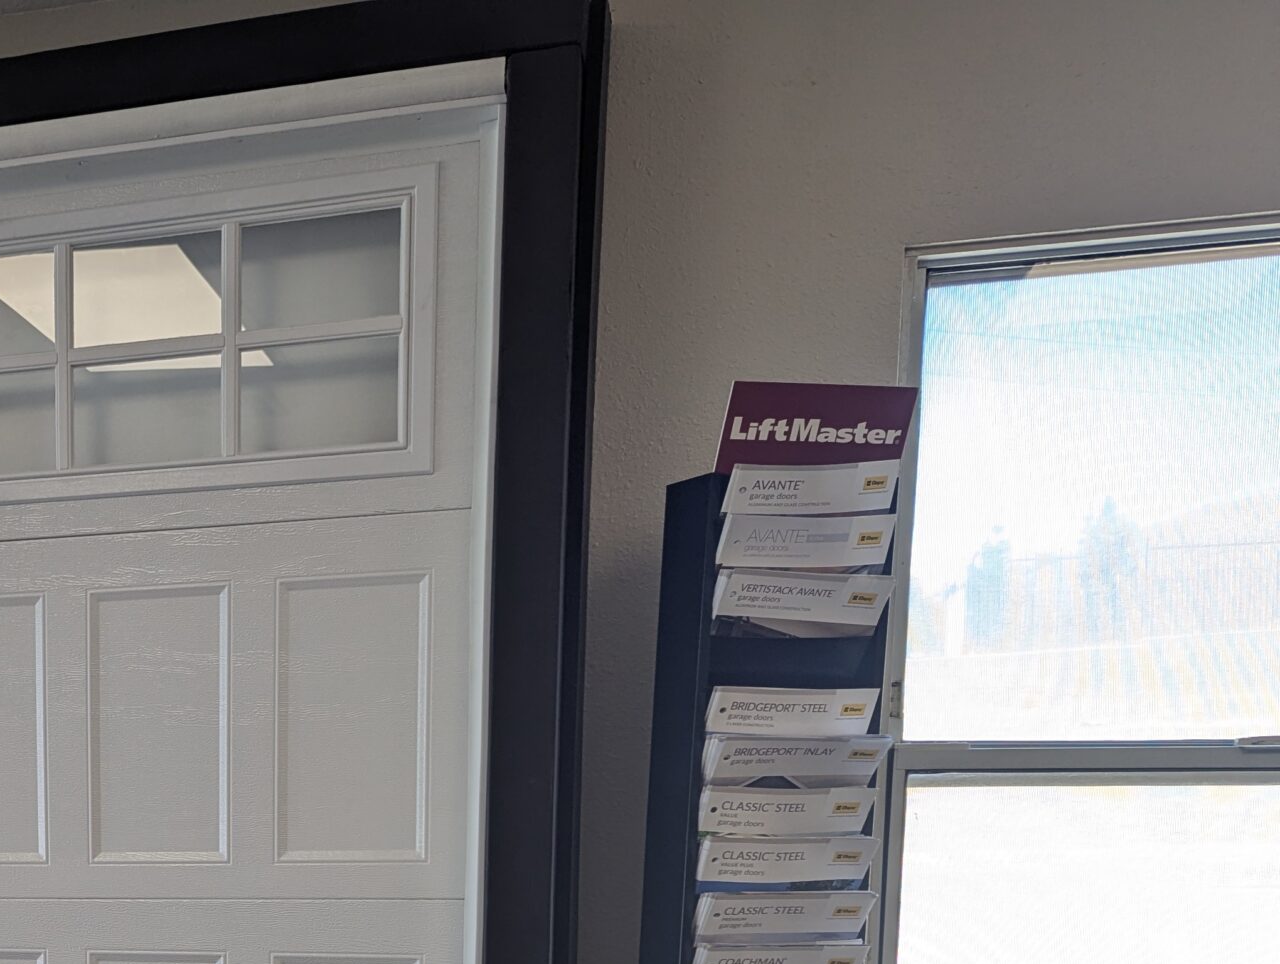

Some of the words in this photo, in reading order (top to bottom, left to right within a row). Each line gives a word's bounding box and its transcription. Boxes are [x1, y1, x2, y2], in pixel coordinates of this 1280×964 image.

[730, 416, 902, 445] LiftMaster
[752, 480, 802, 491] AVANTE
[749, 493, 775, 501] garage
[776, 492, 798, 500] doors
[746, 529, 809, 544] AVANTE
[741, 583, 795, 595] VERTISTACK
[795, 588, 834, 599] AVANTE
[761, 595, 782, 603] doors
[730, 701, 796, 713] BRIDGEPORT
[801, 703, 829, 713] STEEL
[727, 713, 752, 721] garage
[753, 713, 774, 721] doors
[733, 747, 799, 757] BRIDGEPORT
[803, 747, 836, 757] INLAY
[730, 758, 754, 766] garage
[754, 757, 776, 765] doors
[721, 800, 770, 813] CLASSIC
[774, 803, 807, 813] STEEL
[743, 819, 765, 827] doors
[722, 850, 771, 862] CLASSIC
[775, 852, 807, 861] STEEL
[718, 868, 743, 876] garage
[743, 868, 765, 876] doors
[724, 906, 770, 916] CLASSIC
[773, 906, 806, 915] STEEL
